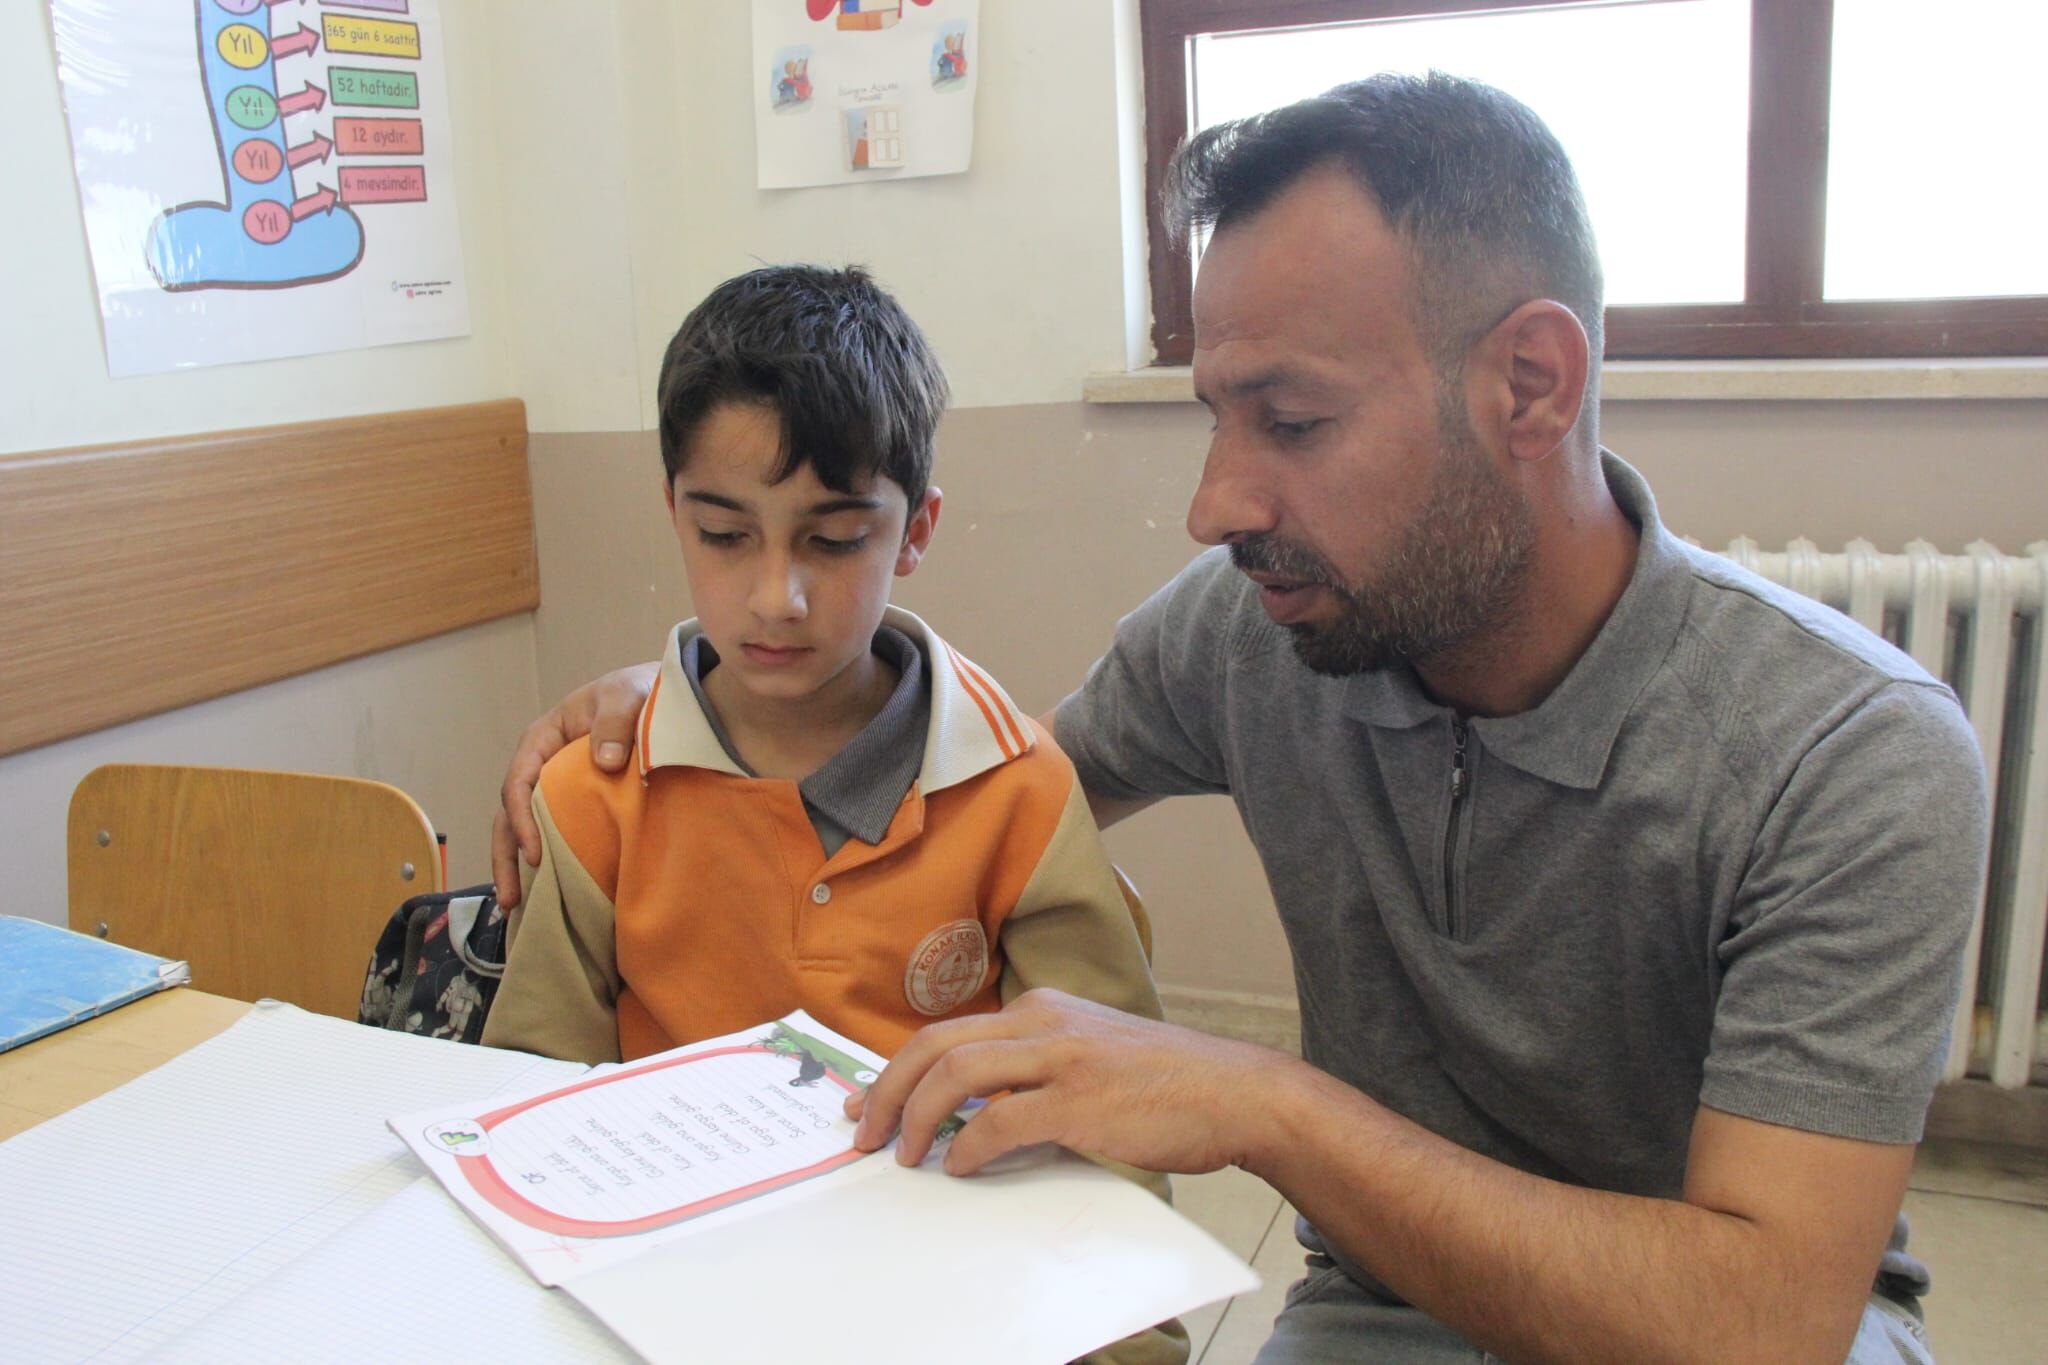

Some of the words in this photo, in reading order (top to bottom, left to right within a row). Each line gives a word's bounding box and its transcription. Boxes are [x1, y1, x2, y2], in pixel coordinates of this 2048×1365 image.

[229, 32, 254, 55] Yıl
[327, 24, 346, 38] 365
[350, 28, 370, 44] gün
[374, 31, 381, 42] 6
[337, 78, 354, 92] 52
[360, 78, 413, 98] haftadır.
[238, 95, 264, 117] Yıl
[352, 128, 366, 142] 12
[373, 129, 408, 147] aydır.
[245, 150, 270, 170] Yıl
[356, 175, 420, 191] mevsimdir.
[255, 213, 279, 233] Yıl
[919, 935, 954, 971] KONAK
